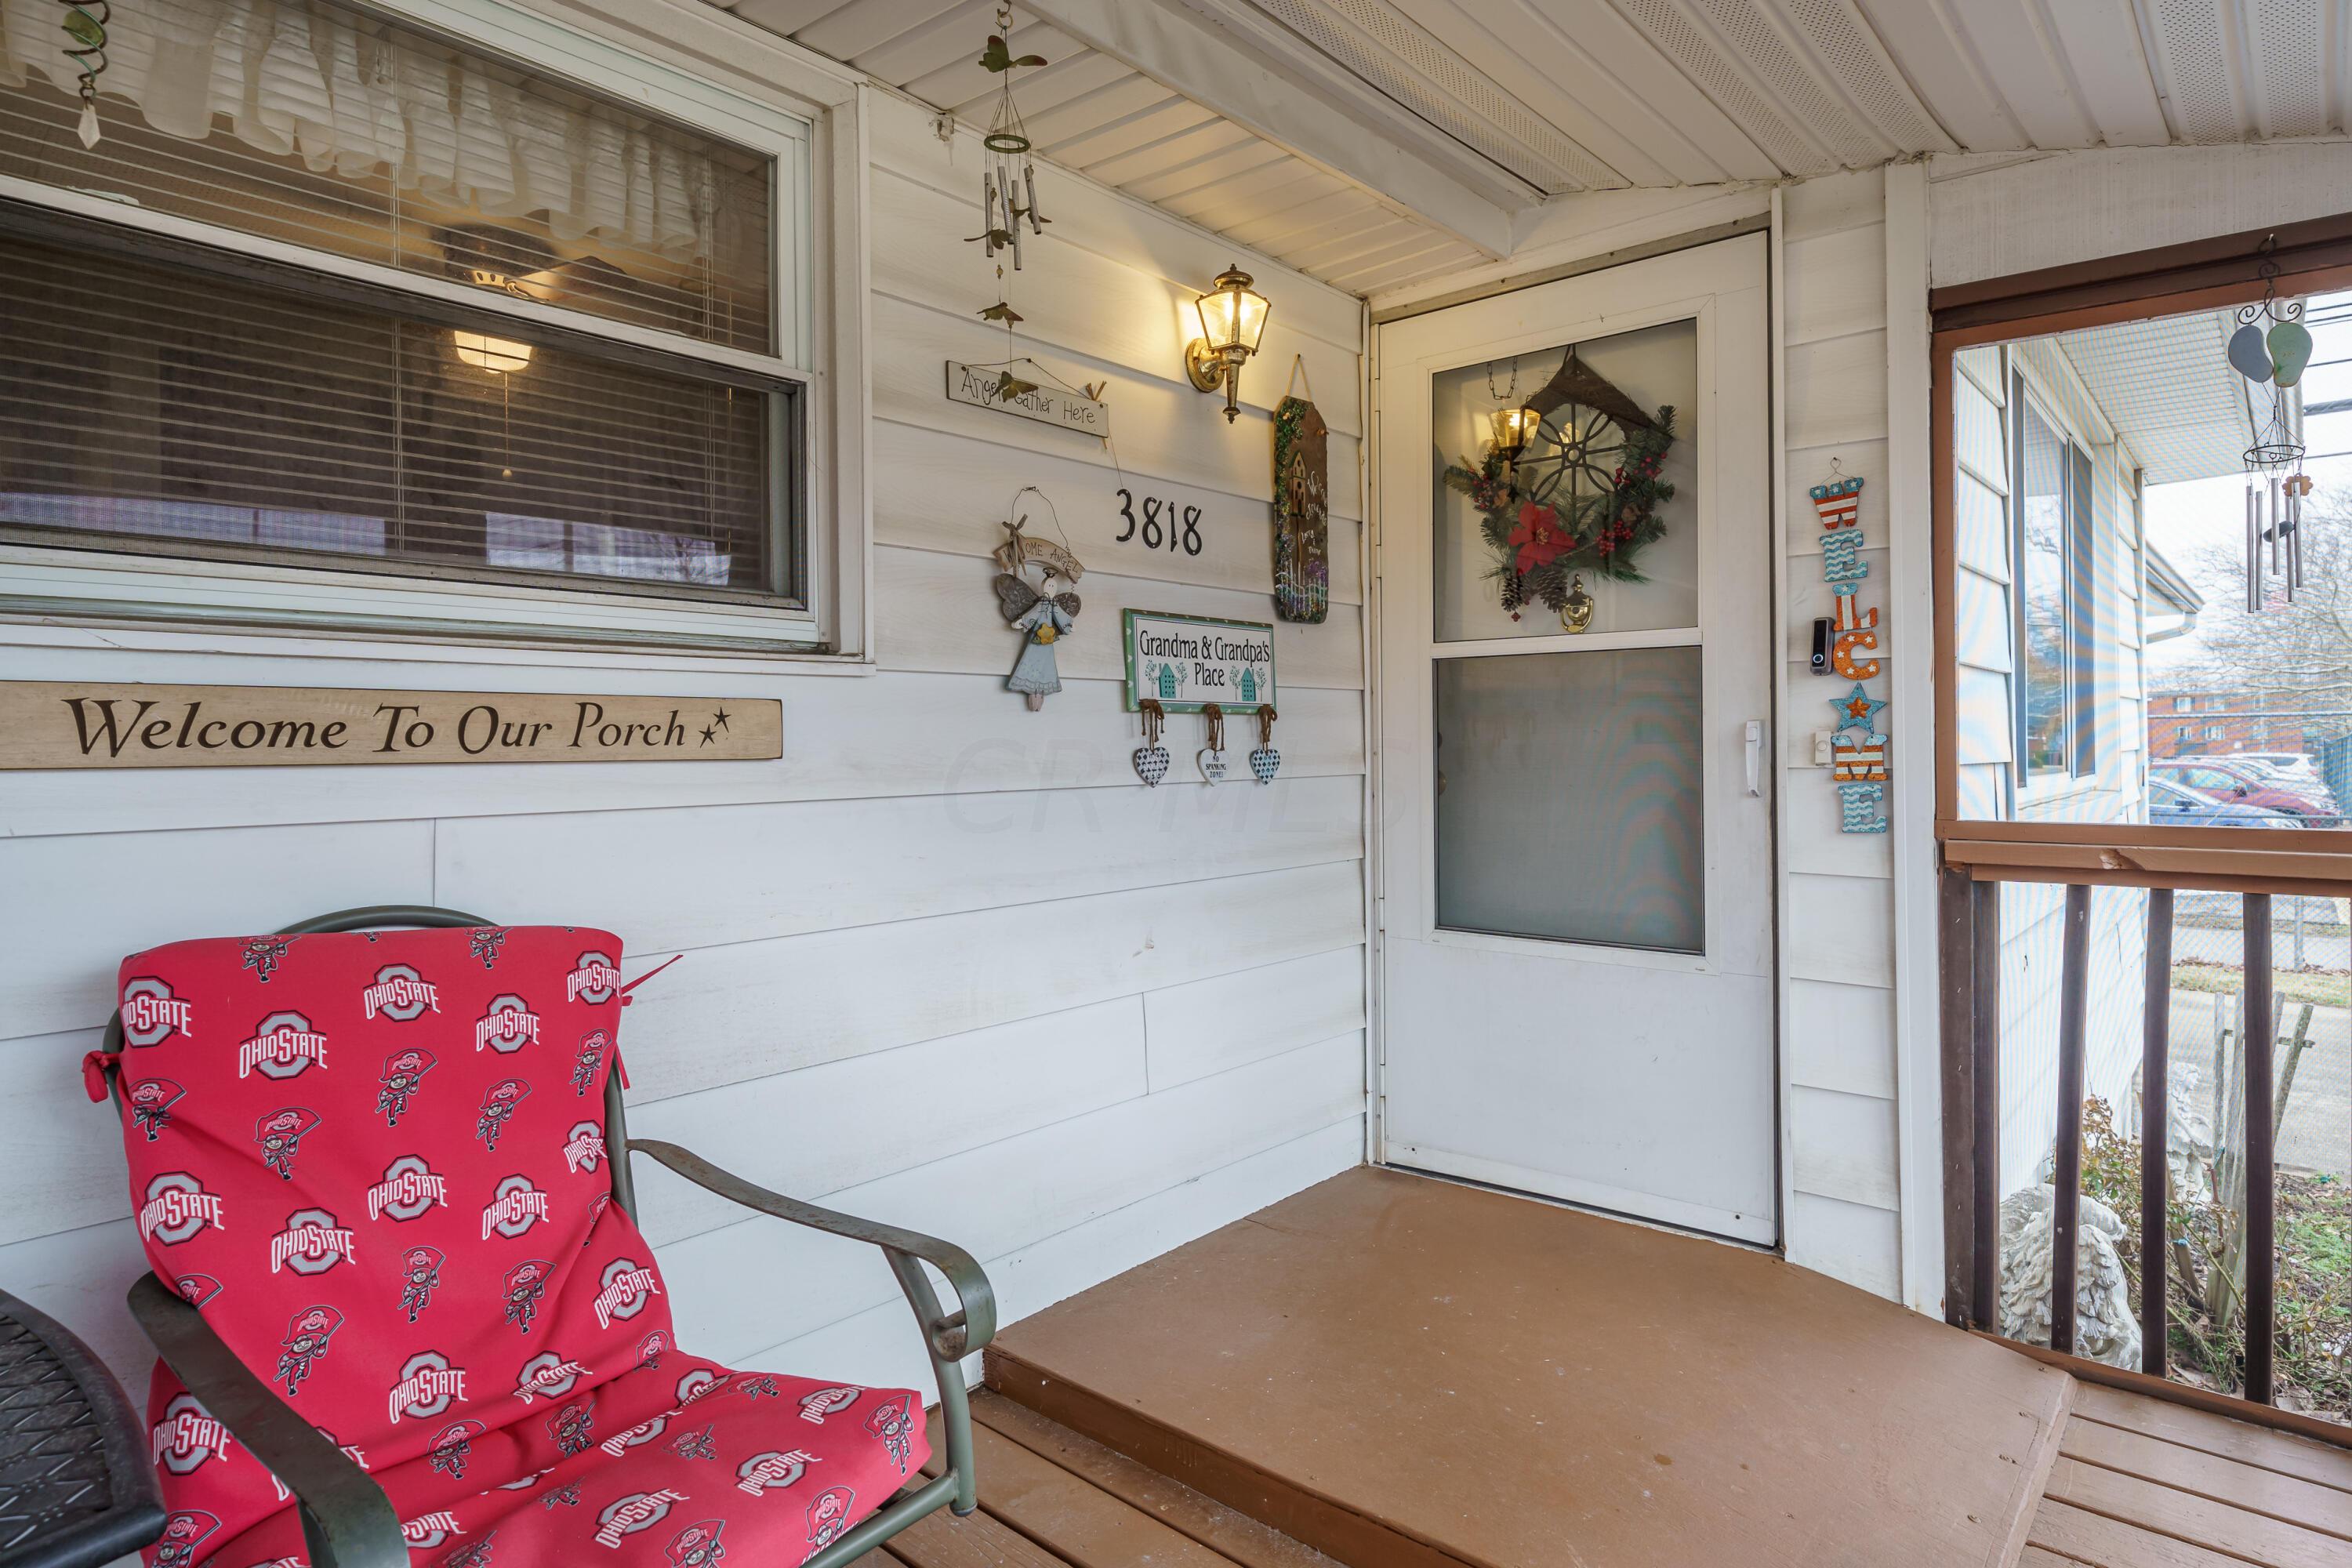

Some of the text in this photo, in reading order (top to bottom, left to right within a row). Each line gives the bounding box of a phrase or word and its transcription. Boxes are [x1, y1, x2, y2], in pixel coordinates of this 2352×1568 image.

[961, 368, 1004, 405] Angel
[1063, 400, 1096, 424] Here
[1116, 488, 1203, 556] 3818
[1003, 542, 1044, 564] WOME
[1139, 630, 1270, 667] Grandma & Grandpa's
[1194, 662, 1225, 687] Place
[61, 696, 687, 759] Welcome To Our Porch
